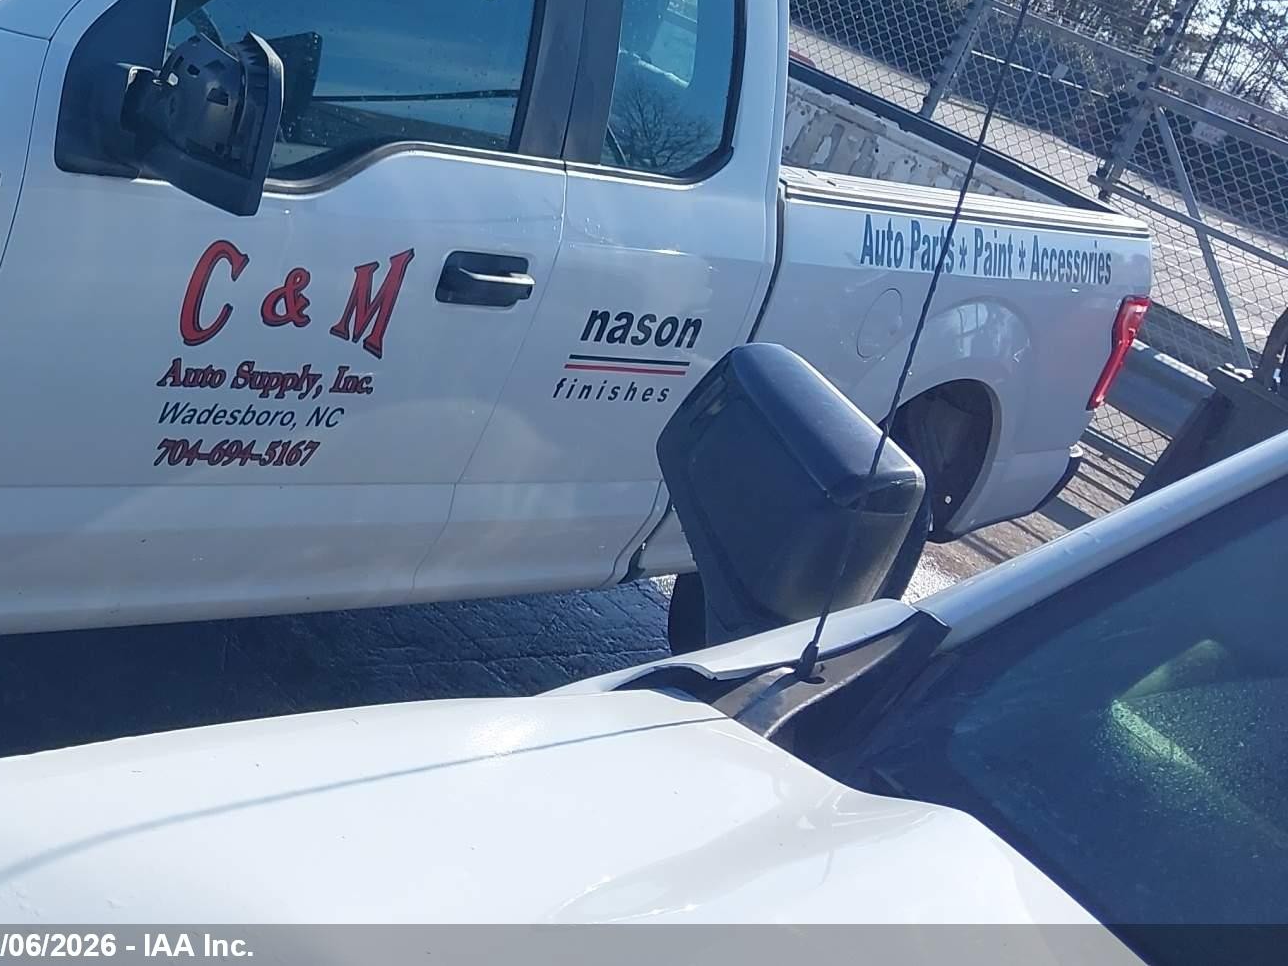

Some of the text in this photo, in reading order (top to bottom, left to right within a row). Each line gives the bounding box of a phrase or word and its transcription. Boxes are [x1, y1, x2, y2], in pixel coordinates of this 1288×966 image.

[860, 213, 904, 269] Auto
[973, 227, 1013, 277] Paint
[1029, 234, 1112, 285] Accessories
[180, 240, 415, 359] C & M
[580, 309, 703, 349] nason
[156, 357, 375, 400] Auto Supply, Inc.
[552, 377, 671, 404] finishes
[157, 401, 345, 431] Wadesboro, NC
[153, 438, 322, 466] 704-694-5167
